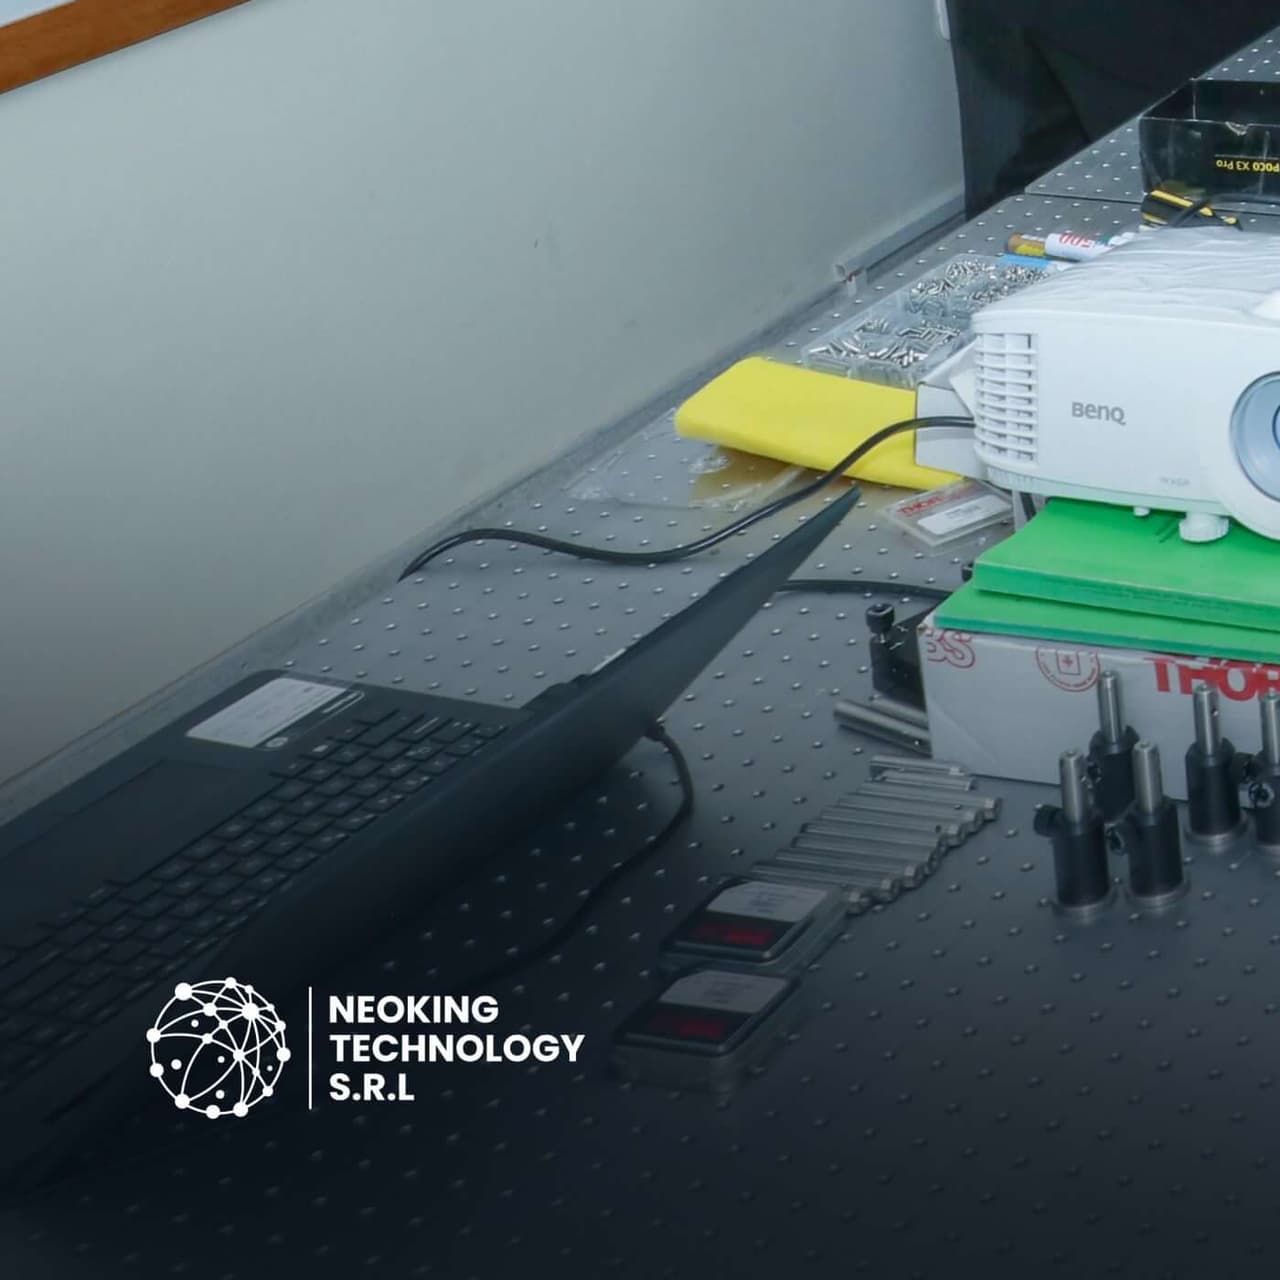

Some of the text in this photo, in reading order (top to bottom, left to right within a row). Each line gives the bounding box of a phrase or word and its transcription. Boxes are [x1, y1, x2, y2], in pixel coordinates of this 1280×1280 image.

[1215, 159, 1280, 172] POCO X3 Pro
[1071, 401, 1127, 426] BenQ
